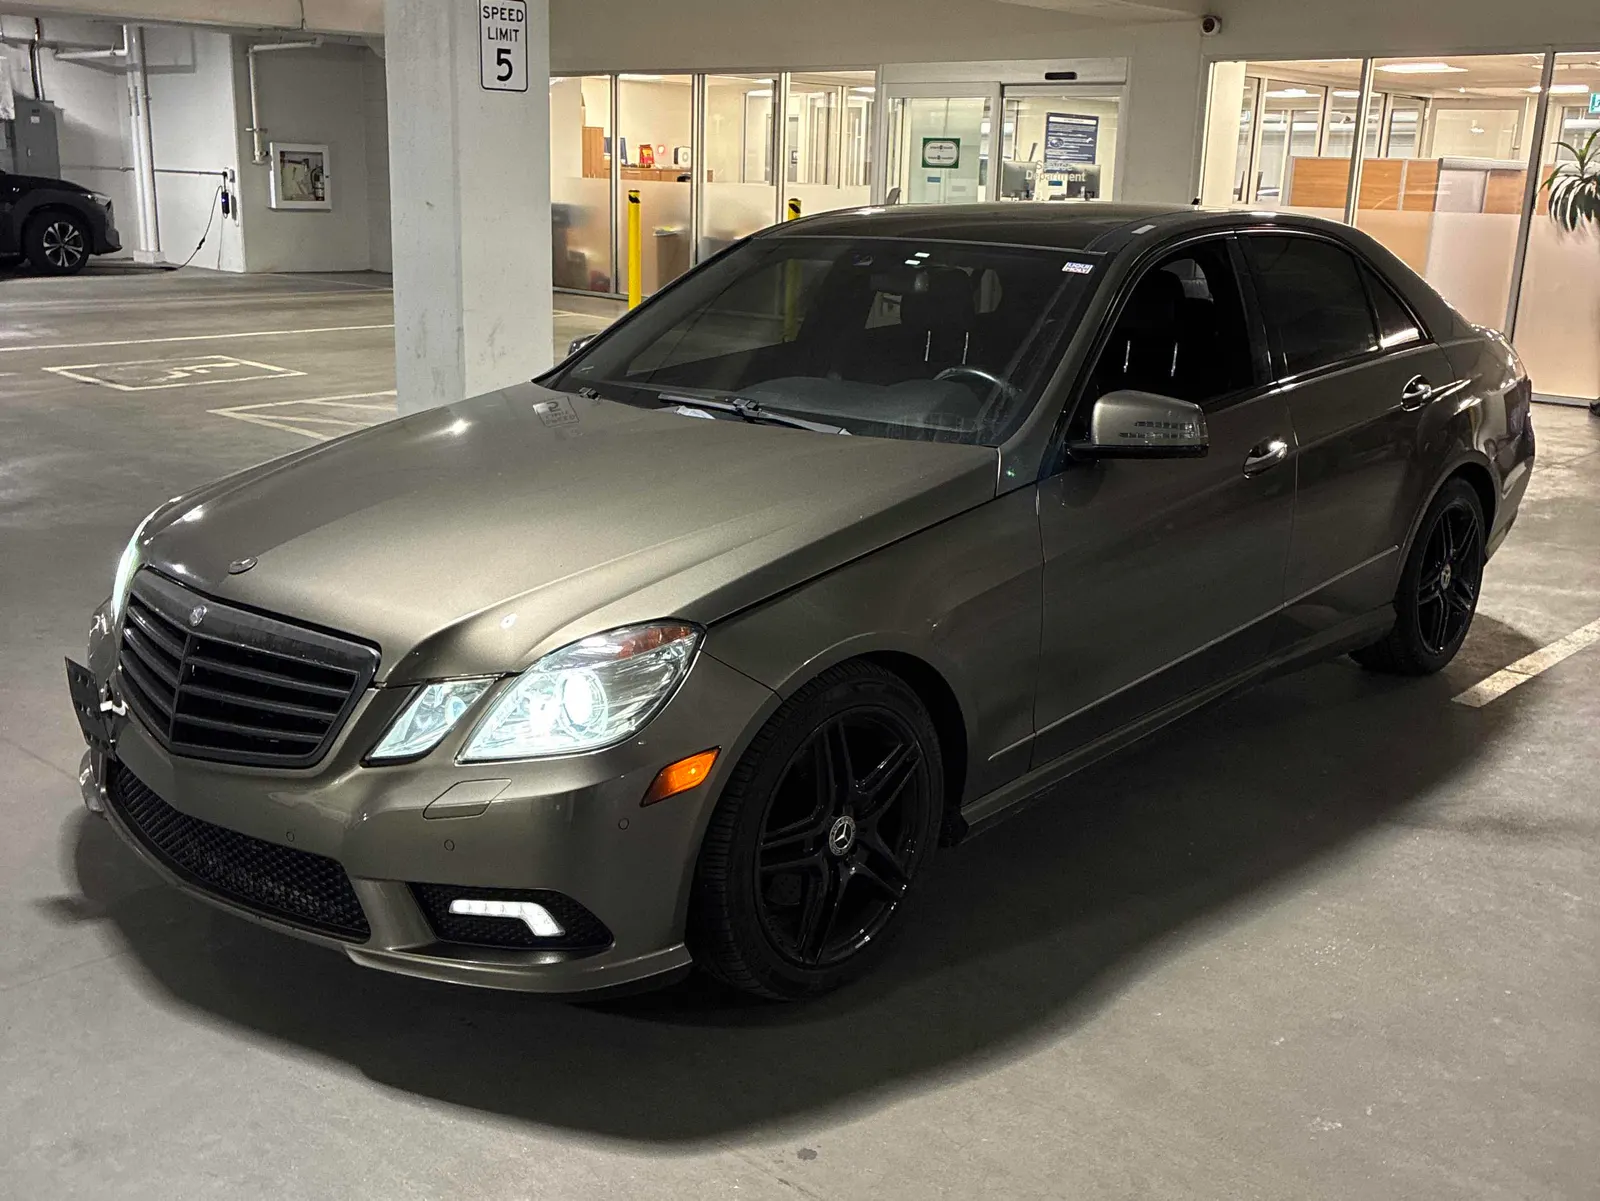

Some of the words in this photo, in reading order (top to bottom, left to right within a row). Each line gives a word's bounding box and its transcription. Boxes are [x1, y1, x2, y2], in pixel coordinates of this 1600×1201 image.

[482, 5, 524, 22] SPEED
[487, 26, 520, 42] LIMIT
[496, 47, 513, 82] 5
[1025, 170, 1086, 182] Department
